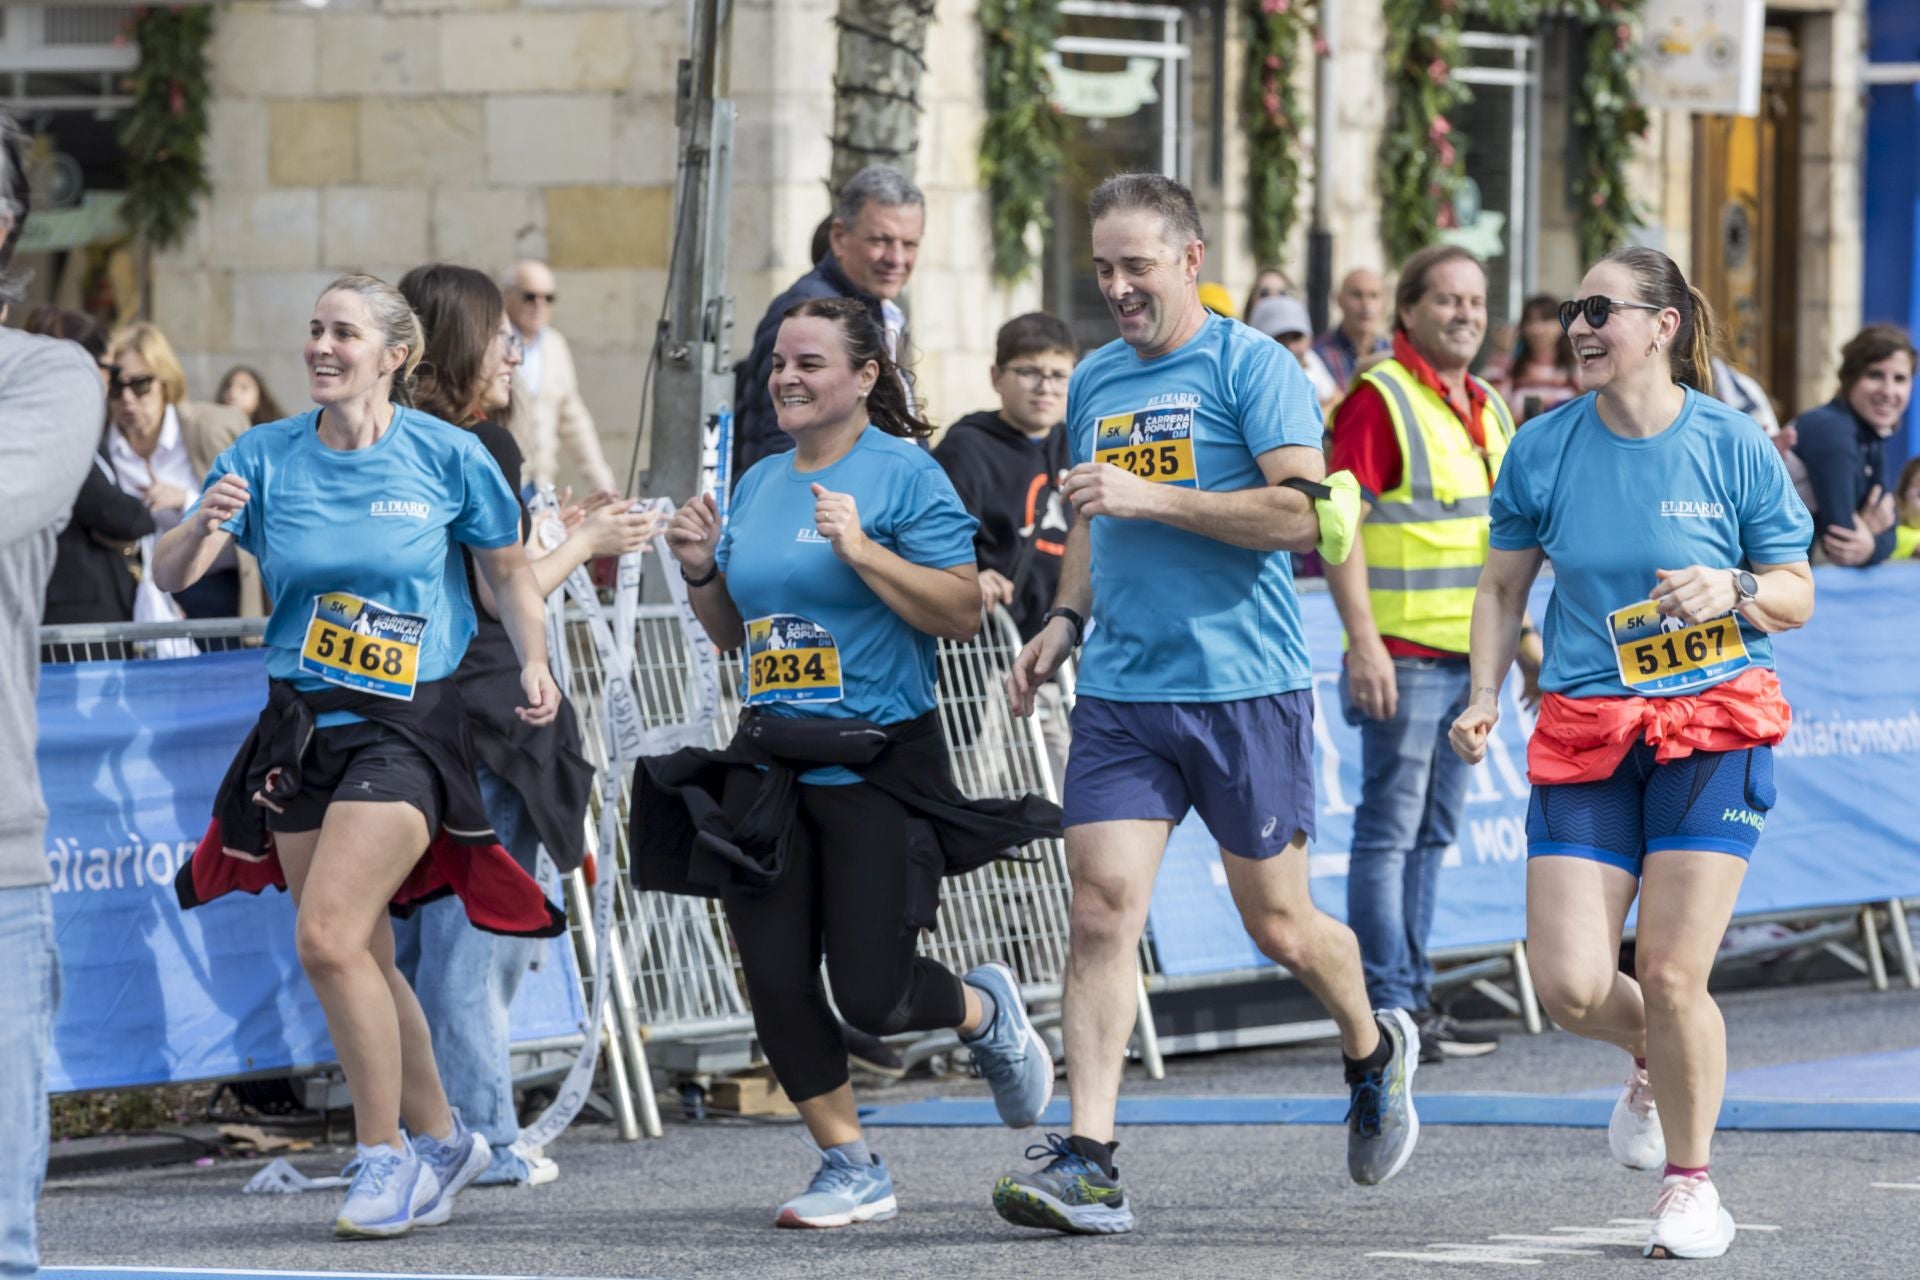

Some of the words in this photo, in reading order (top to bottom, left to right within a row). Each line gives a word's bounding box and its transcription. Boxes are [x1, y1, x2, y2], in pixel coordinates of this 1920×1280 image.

[1160, 393, 1201, 405] DIARIO
[1145, 414, 1190, 425] CARRERA
[1106, 427, 1121, 438] 5K
[1144, 422, 1190, 433] POPULAR
[371, 501, 387, 513] EL
[387, 501, 430, 515] DIARIO
[1661, 501, 1678, 513] EL
[1679, 501, 1725, 514] DIARIO
[328, 600, 349, 616] 5K
[372, 619, 421, 637] POPULAR
[1626, 615, 1646, 630] 5K
[316, 628, 403, 676] 5168
[1634, 624, 1725, 675] 5167
[754, 652, 826, 688] 5234
